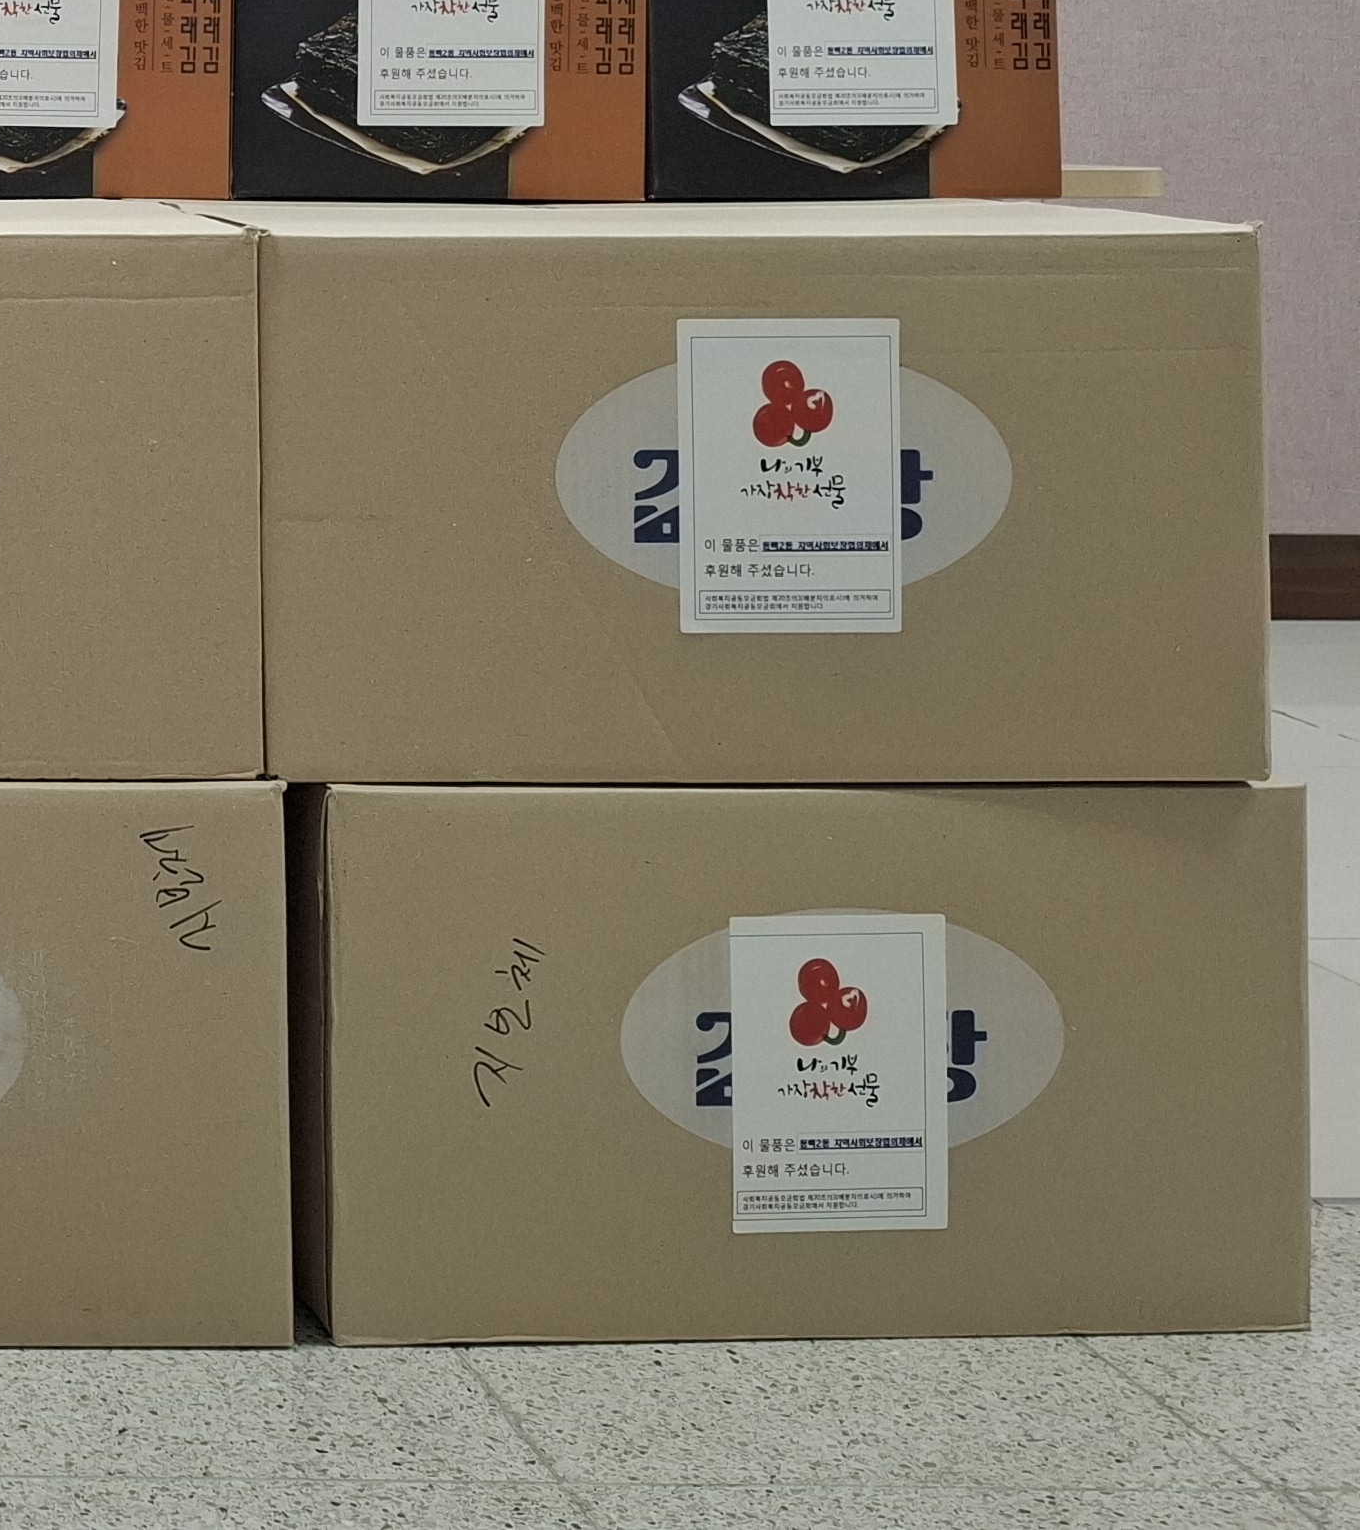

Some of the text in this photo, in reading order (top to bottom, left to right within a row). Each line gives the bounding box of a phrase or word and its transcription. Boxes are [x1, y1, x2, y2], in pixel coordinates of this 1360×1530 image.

[380, 67, 472, 80] 후원해 주셨습니다.
[778, 66, 871, 79] 후원해 주셨습니다.
[705, 563, 814, 578] 후원해 주셨습니다.
[743, 1161, 849, 1179] 후원해 주셨습니다.
